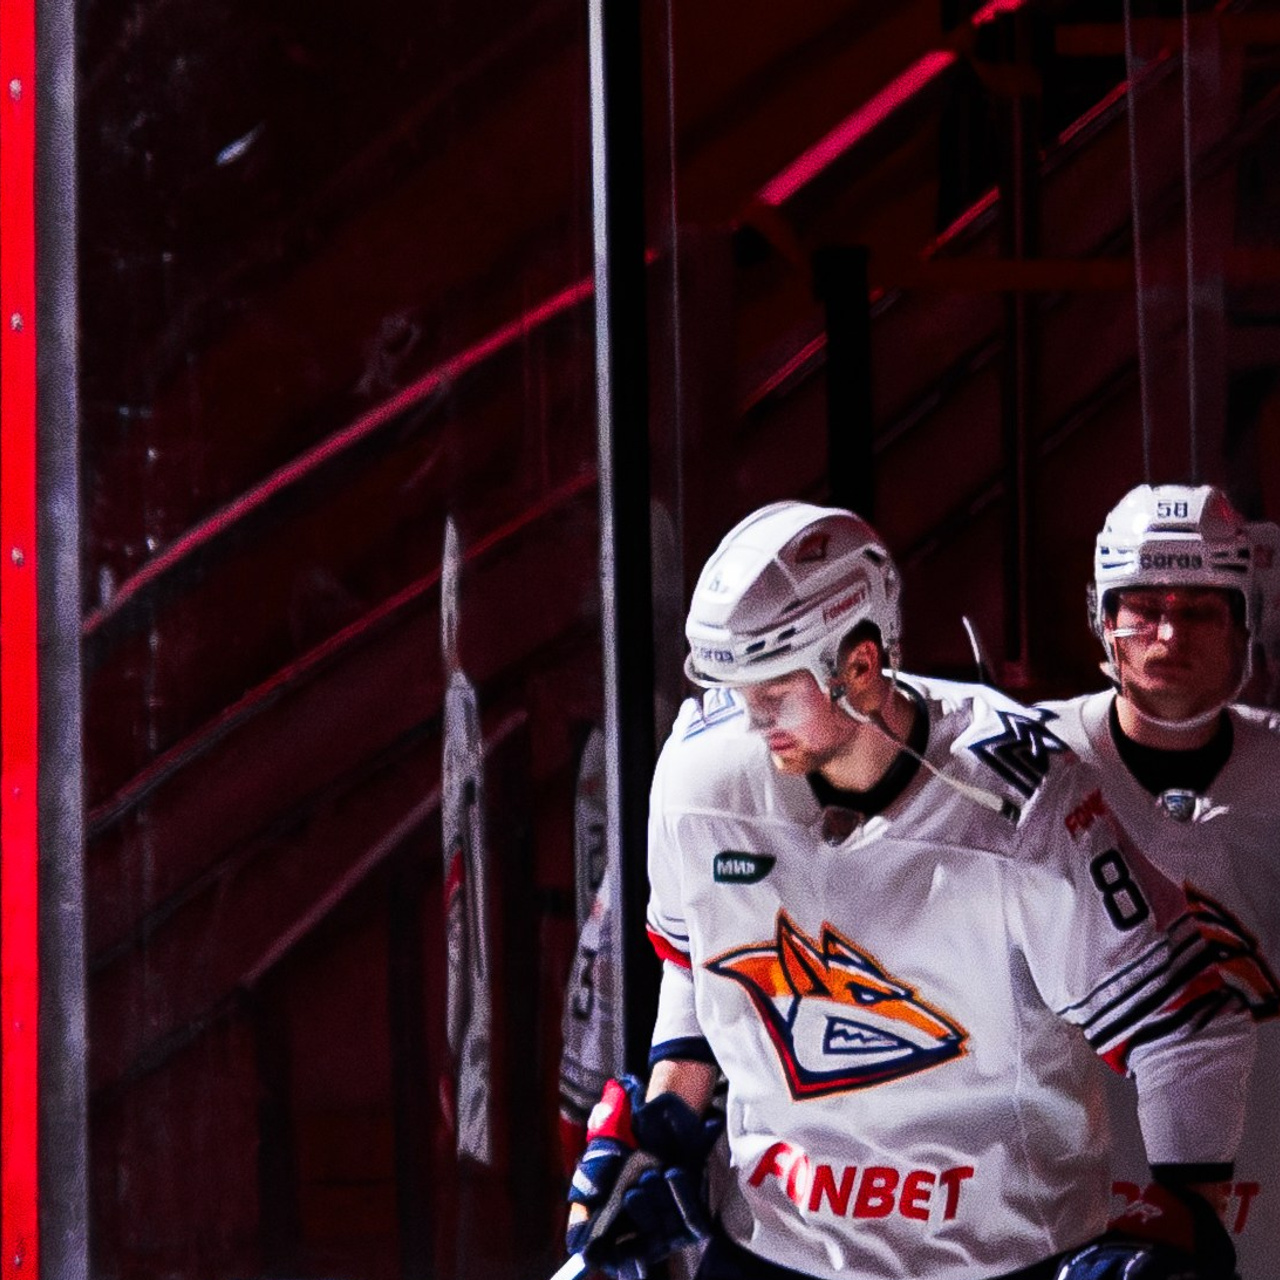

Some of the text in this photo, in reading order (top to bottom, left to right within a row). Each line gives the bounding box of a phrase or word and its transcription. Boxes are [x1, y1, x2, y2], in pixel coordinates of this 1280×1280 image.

[1156, 501, 1189, 519] 58
[1089, 850, 1149, 932] 8
[747, 1141, 975, 1222] FONBET
